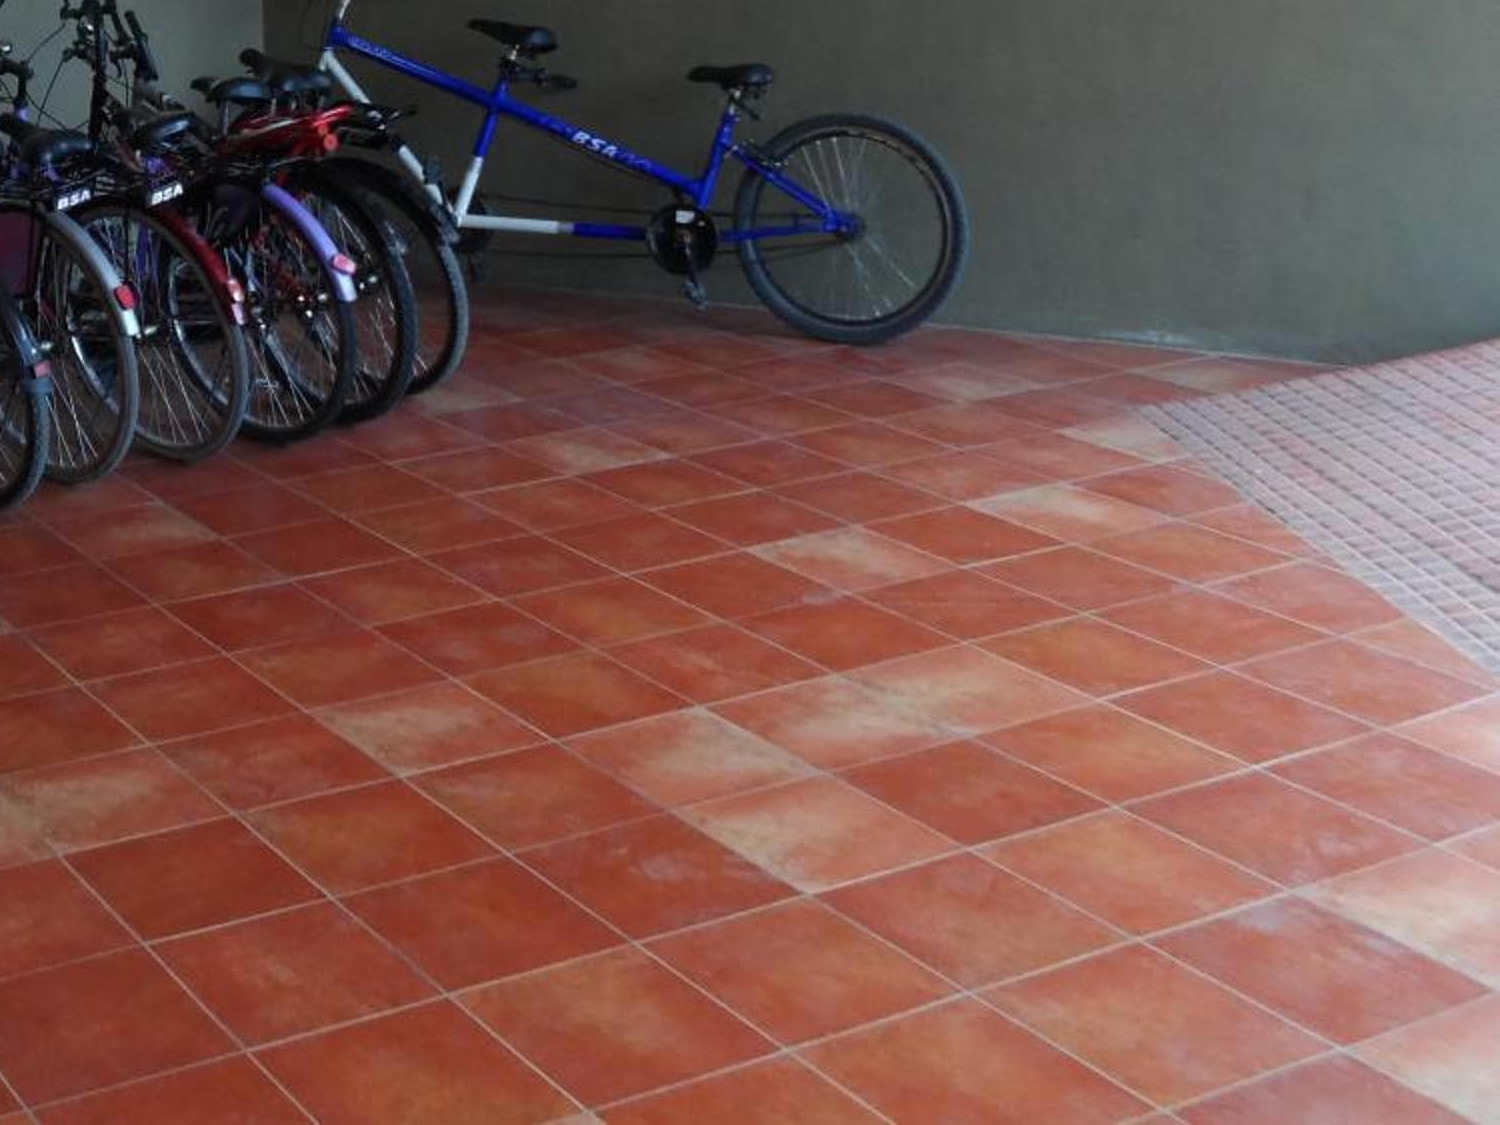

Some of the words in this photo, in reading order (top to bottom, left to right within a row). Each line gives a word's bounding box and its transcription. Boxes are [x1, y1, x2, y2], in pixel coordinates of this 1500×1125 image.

[572, 131, 618, 158] BSA
[57, 188, 91, 210] BSA
[152, 183, 184, 206] BSA
